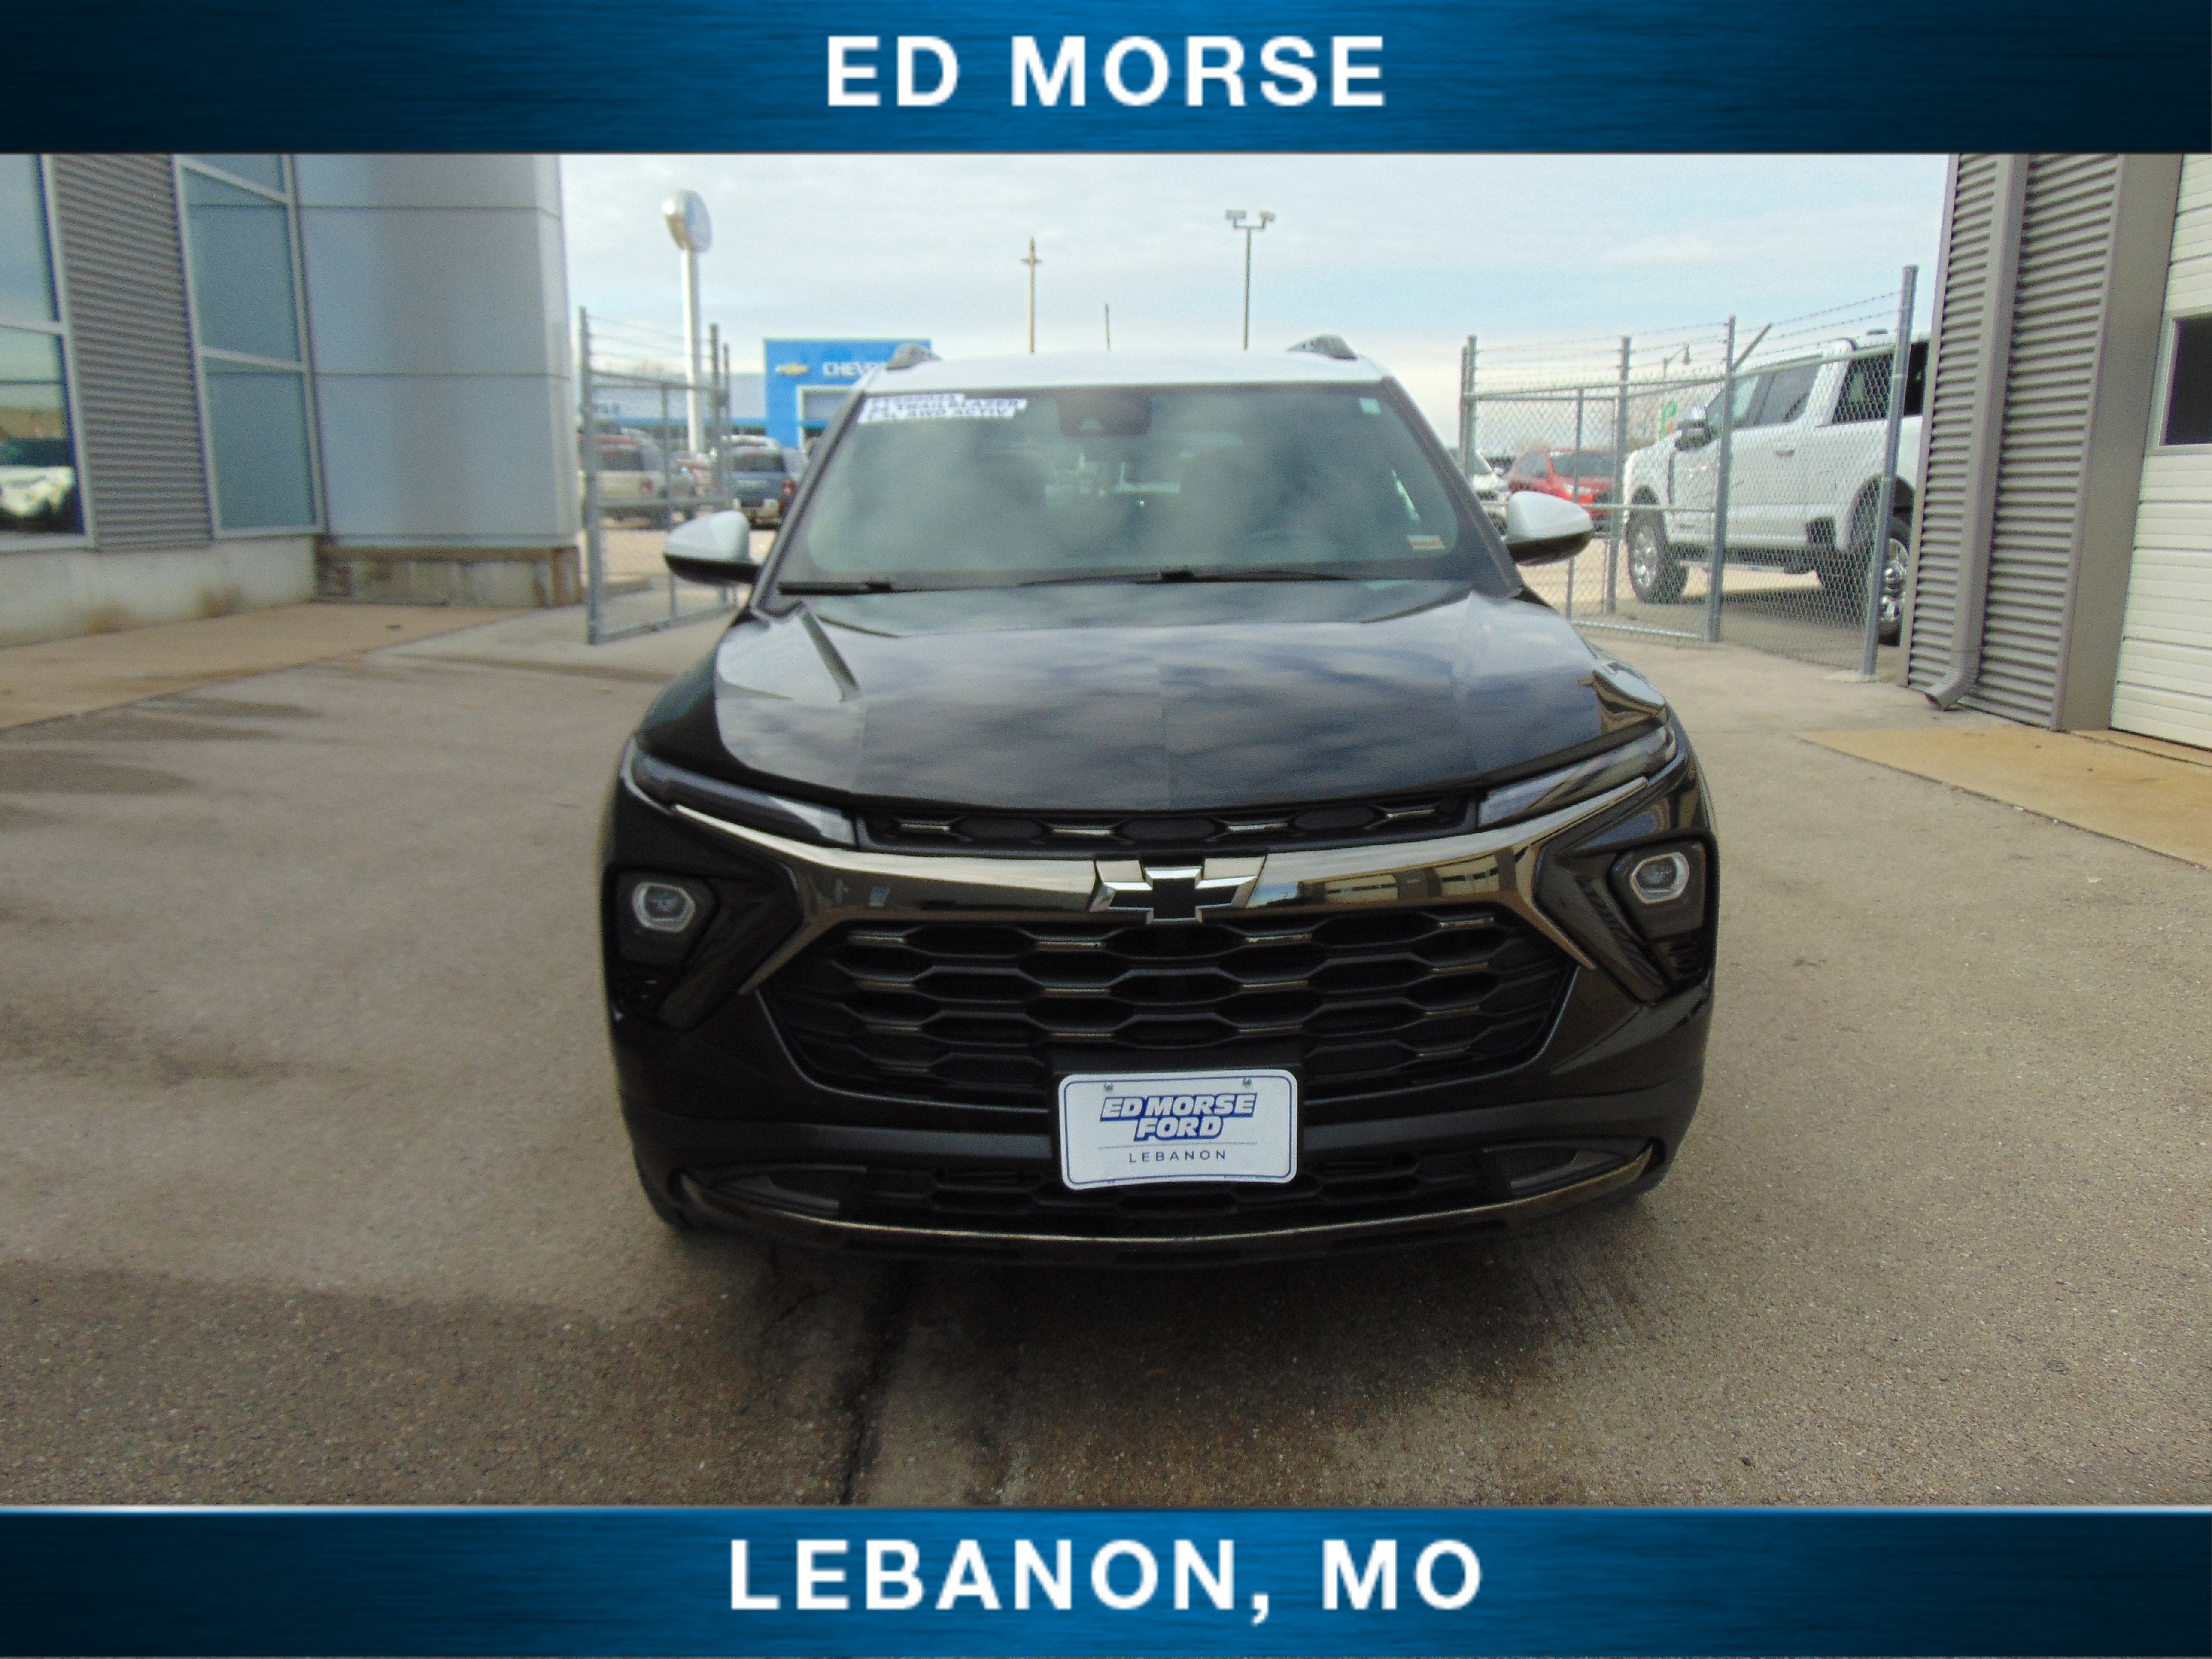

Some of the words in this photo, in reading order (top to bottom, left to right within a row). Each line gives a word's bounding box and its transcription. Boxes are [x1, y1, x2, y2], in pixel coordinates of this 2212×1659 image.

[1100, 1097, 1143, 1121] ED
[1142, 1094, 1257, 1118] MORSE
[1134, 1115, 1224, 1142] FORD
[1129, 1150, 1226, 1163] LEBANON
